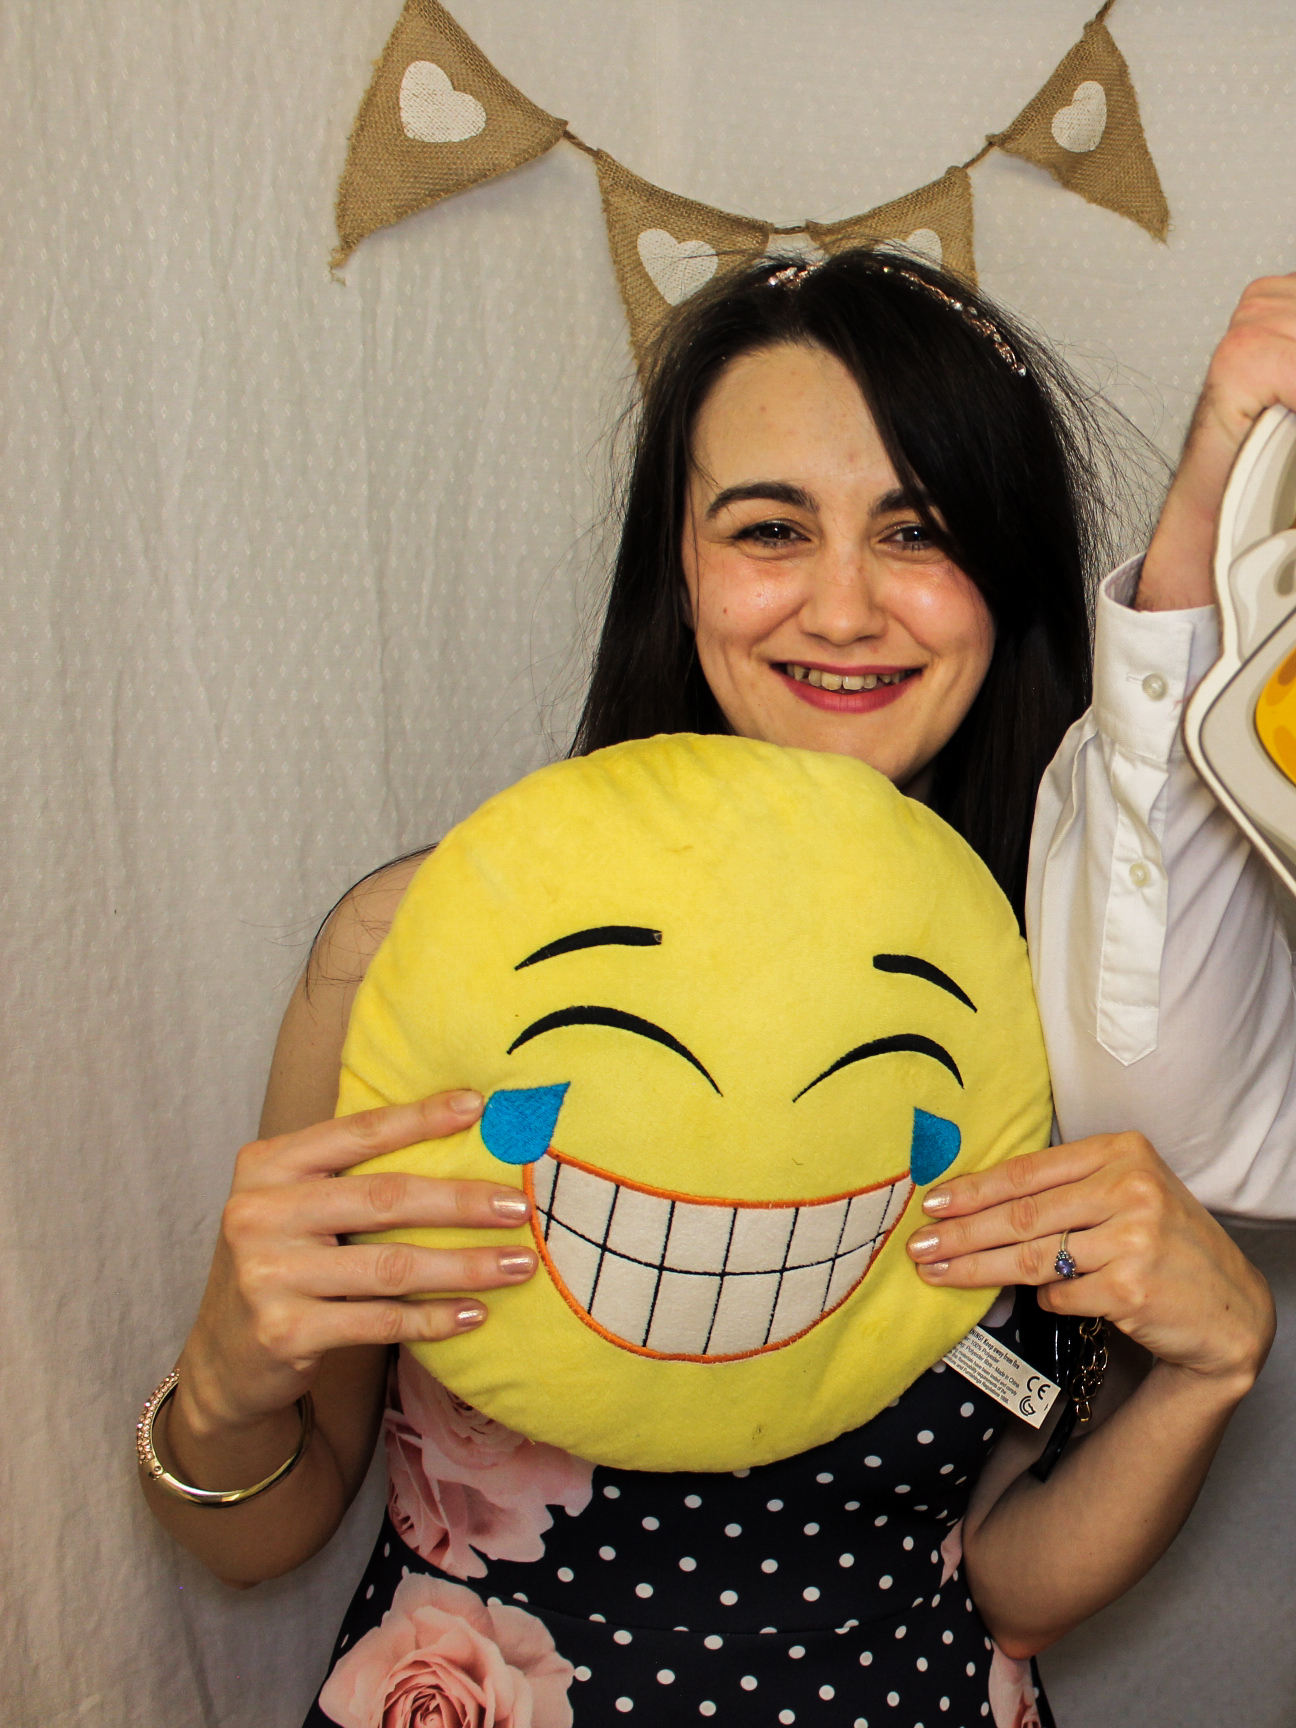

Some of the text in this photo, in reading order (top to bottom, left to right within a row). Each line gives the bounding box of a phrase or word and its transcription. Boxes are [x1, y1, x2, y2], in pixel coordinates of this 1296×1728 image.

[971, 1340, 982, 1351] 100%
[983, 1338, 994, 1350] Keep
[993, 1347, 1004, 1358] away
[1003, 1353, 1013, 1364] from
[1012, 1360, 1020, 1370] fire
[1009, 1377, 1020, 1388] China
[1027, 1376, 1051, 1400] CE
